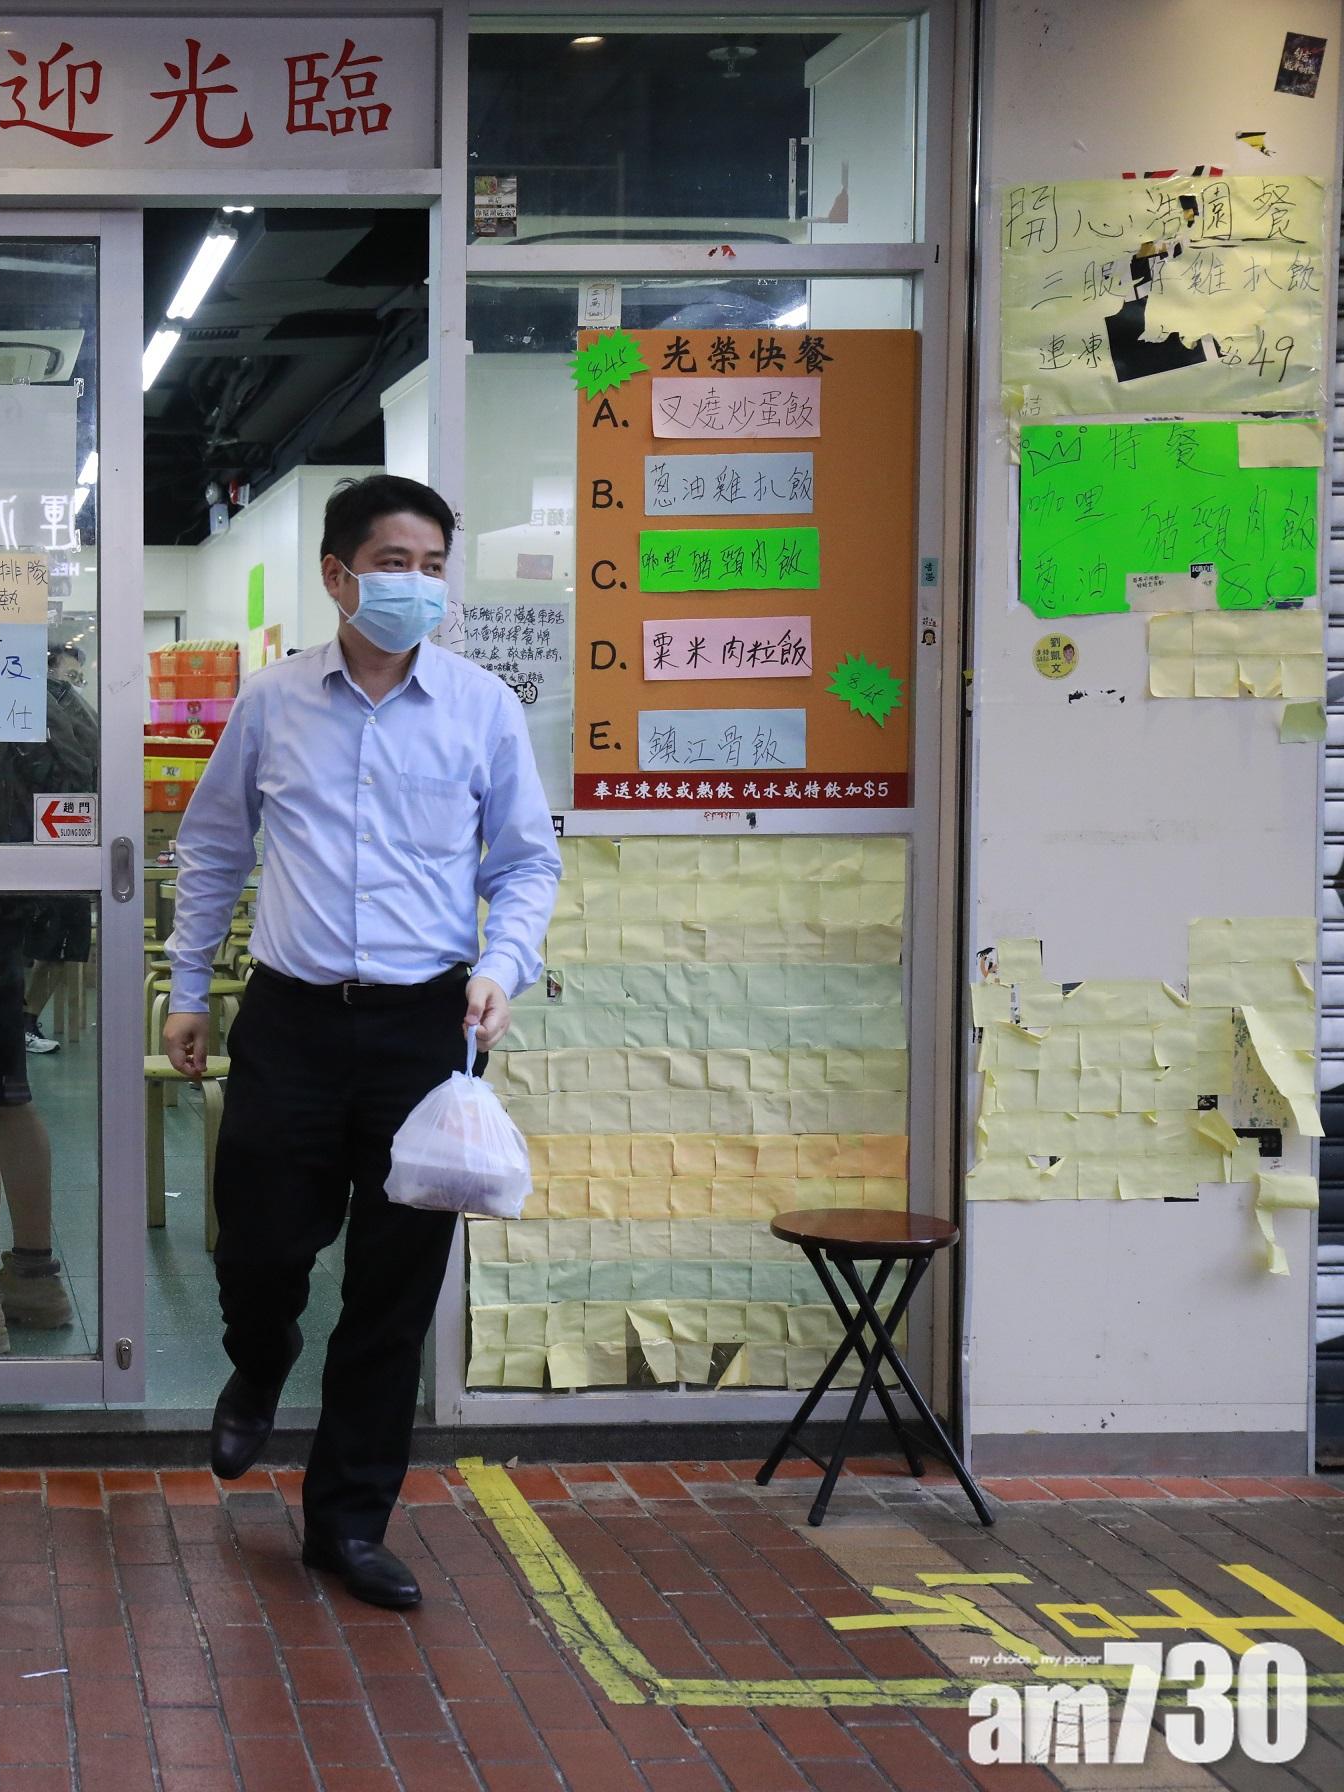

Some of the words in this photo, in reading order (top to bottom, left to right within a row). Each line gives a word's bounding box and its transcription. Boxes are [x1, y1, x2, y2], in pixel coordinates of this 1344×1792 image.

[661, 334, 835, 374] 光榮快餐
[592, 398, 630, 428] A.
[657, 386, 814, 432] 叉燒炒蛋飯
[591, 479, 624, 509] B.
[650, 463, 814, 508] 蔥油雞扒飯
[591, 560, 628, 590] C.
[590, 640, 627, 671] D.
[652, 629, 813, 670] 粟米肉粒飯
[589, 720, 622, 751] E.
[647, 725, 787, 766] 鎮江骨飯
[593, 780, 735, 800] 奉送凍飲或熱飲
[743, 780, 889, 800] 汽水或特飲加$5
[63, 801, 90, 814] 趟門
[60, 828, 77, 837] SLIDING
[79, 828, 92, 837] DOOR
